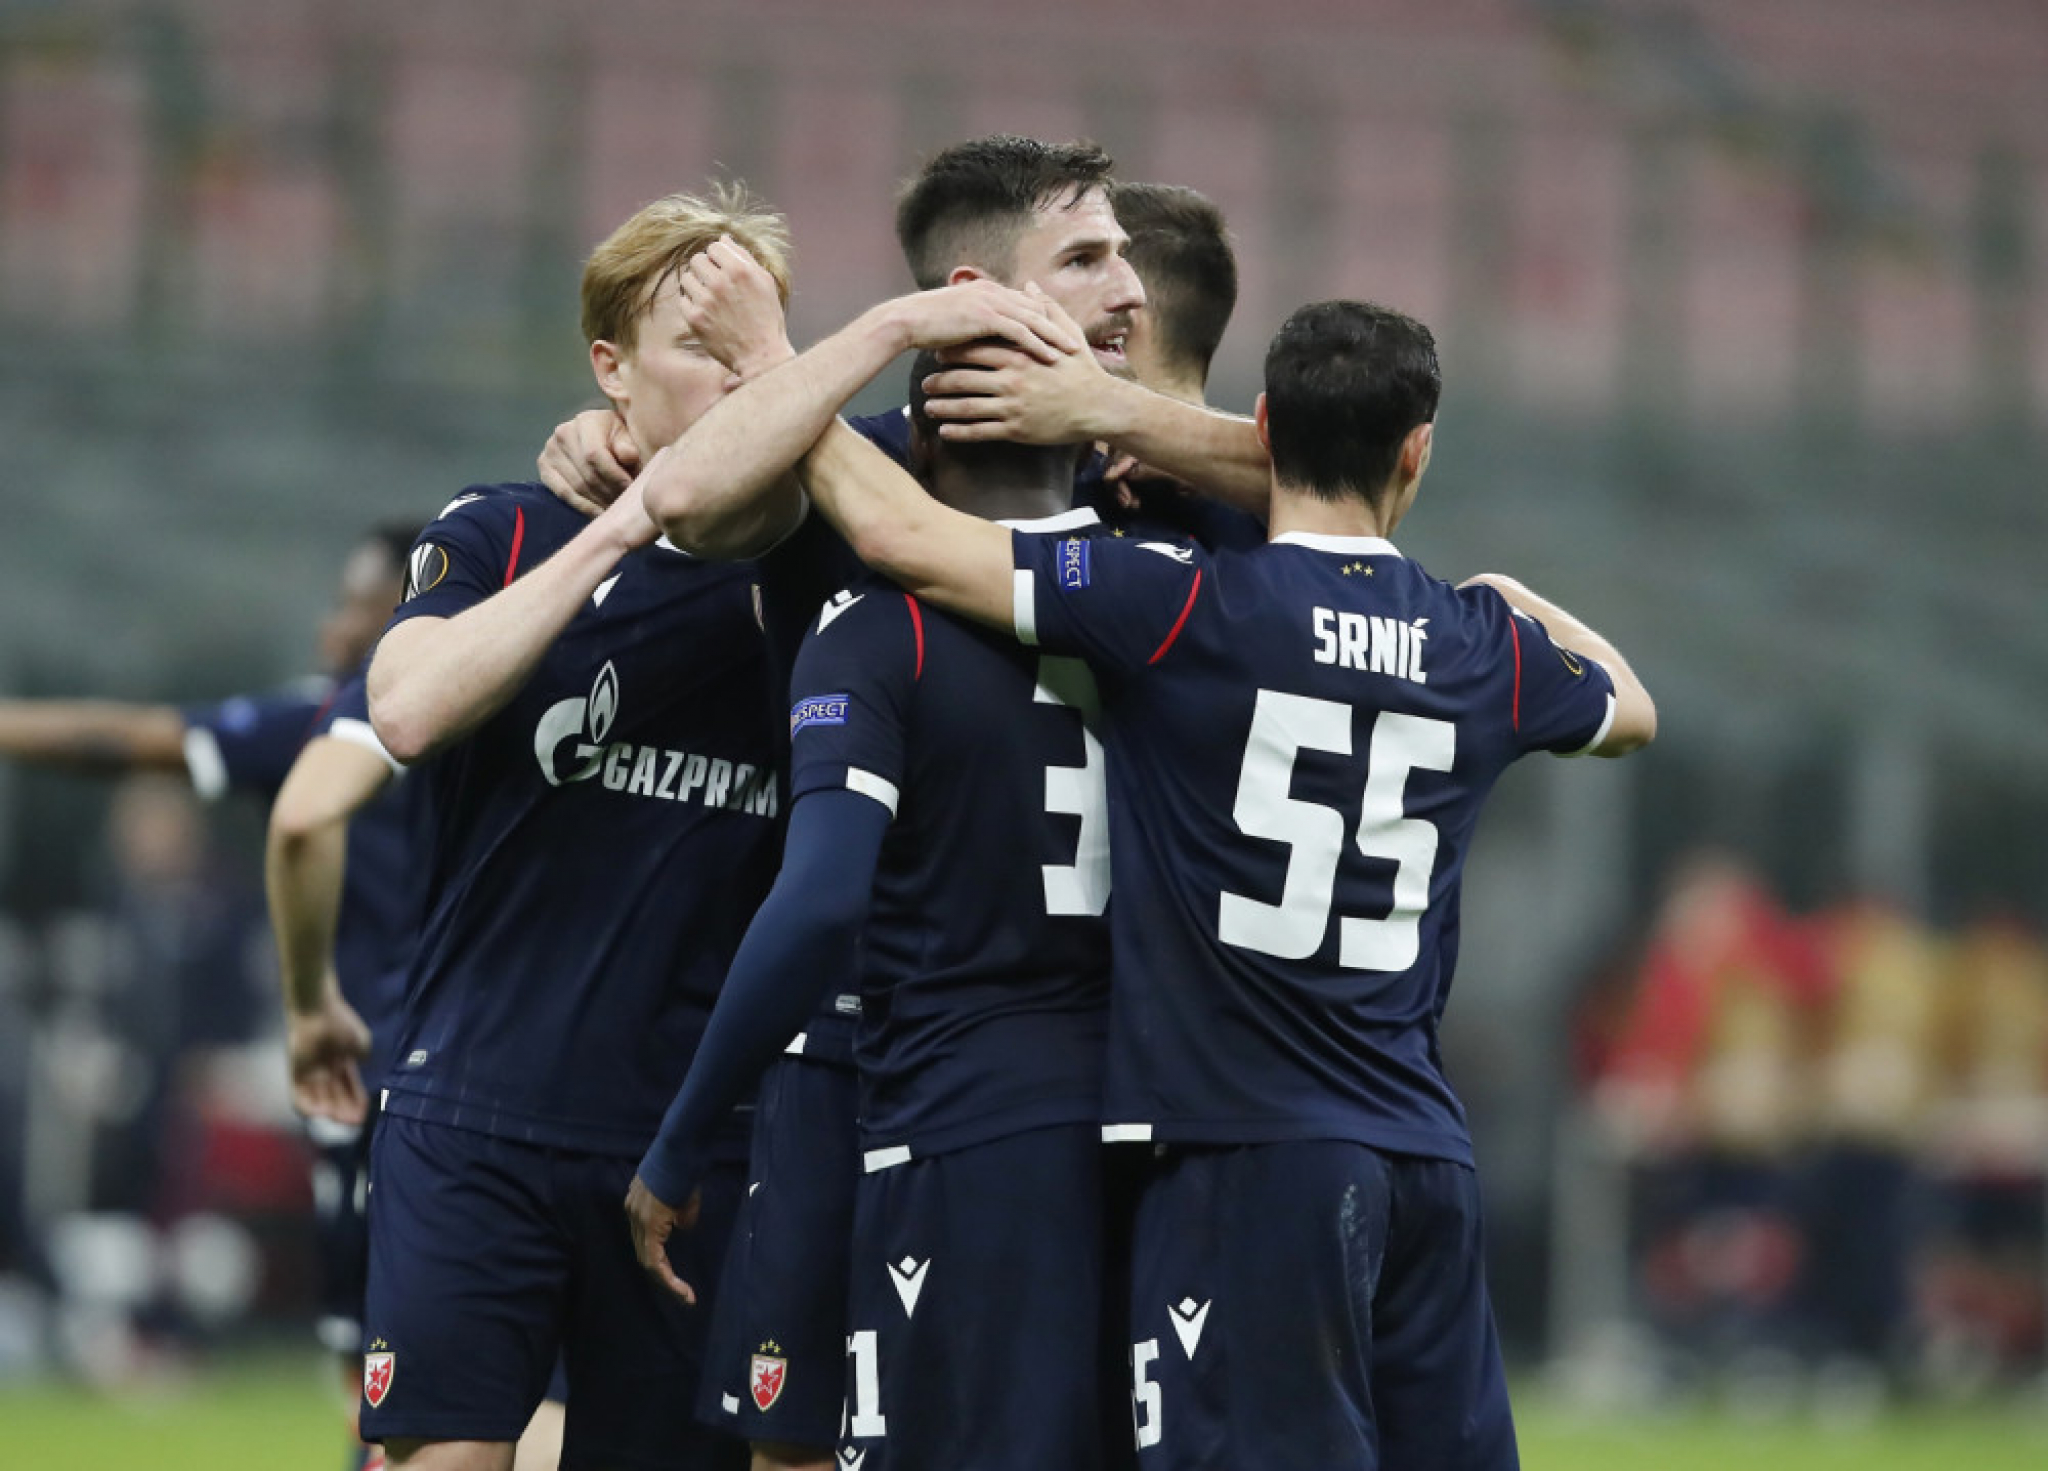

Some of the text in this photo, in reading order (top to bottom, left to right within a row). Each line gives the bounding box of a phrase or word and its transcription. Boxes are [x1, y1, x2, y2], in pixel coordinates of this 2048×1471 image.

[1312, 606, 1430, 684] SRNIĆ
[601, 742, 778, 818] GAZPROM
[1218, 688, 1457, 972] 55
